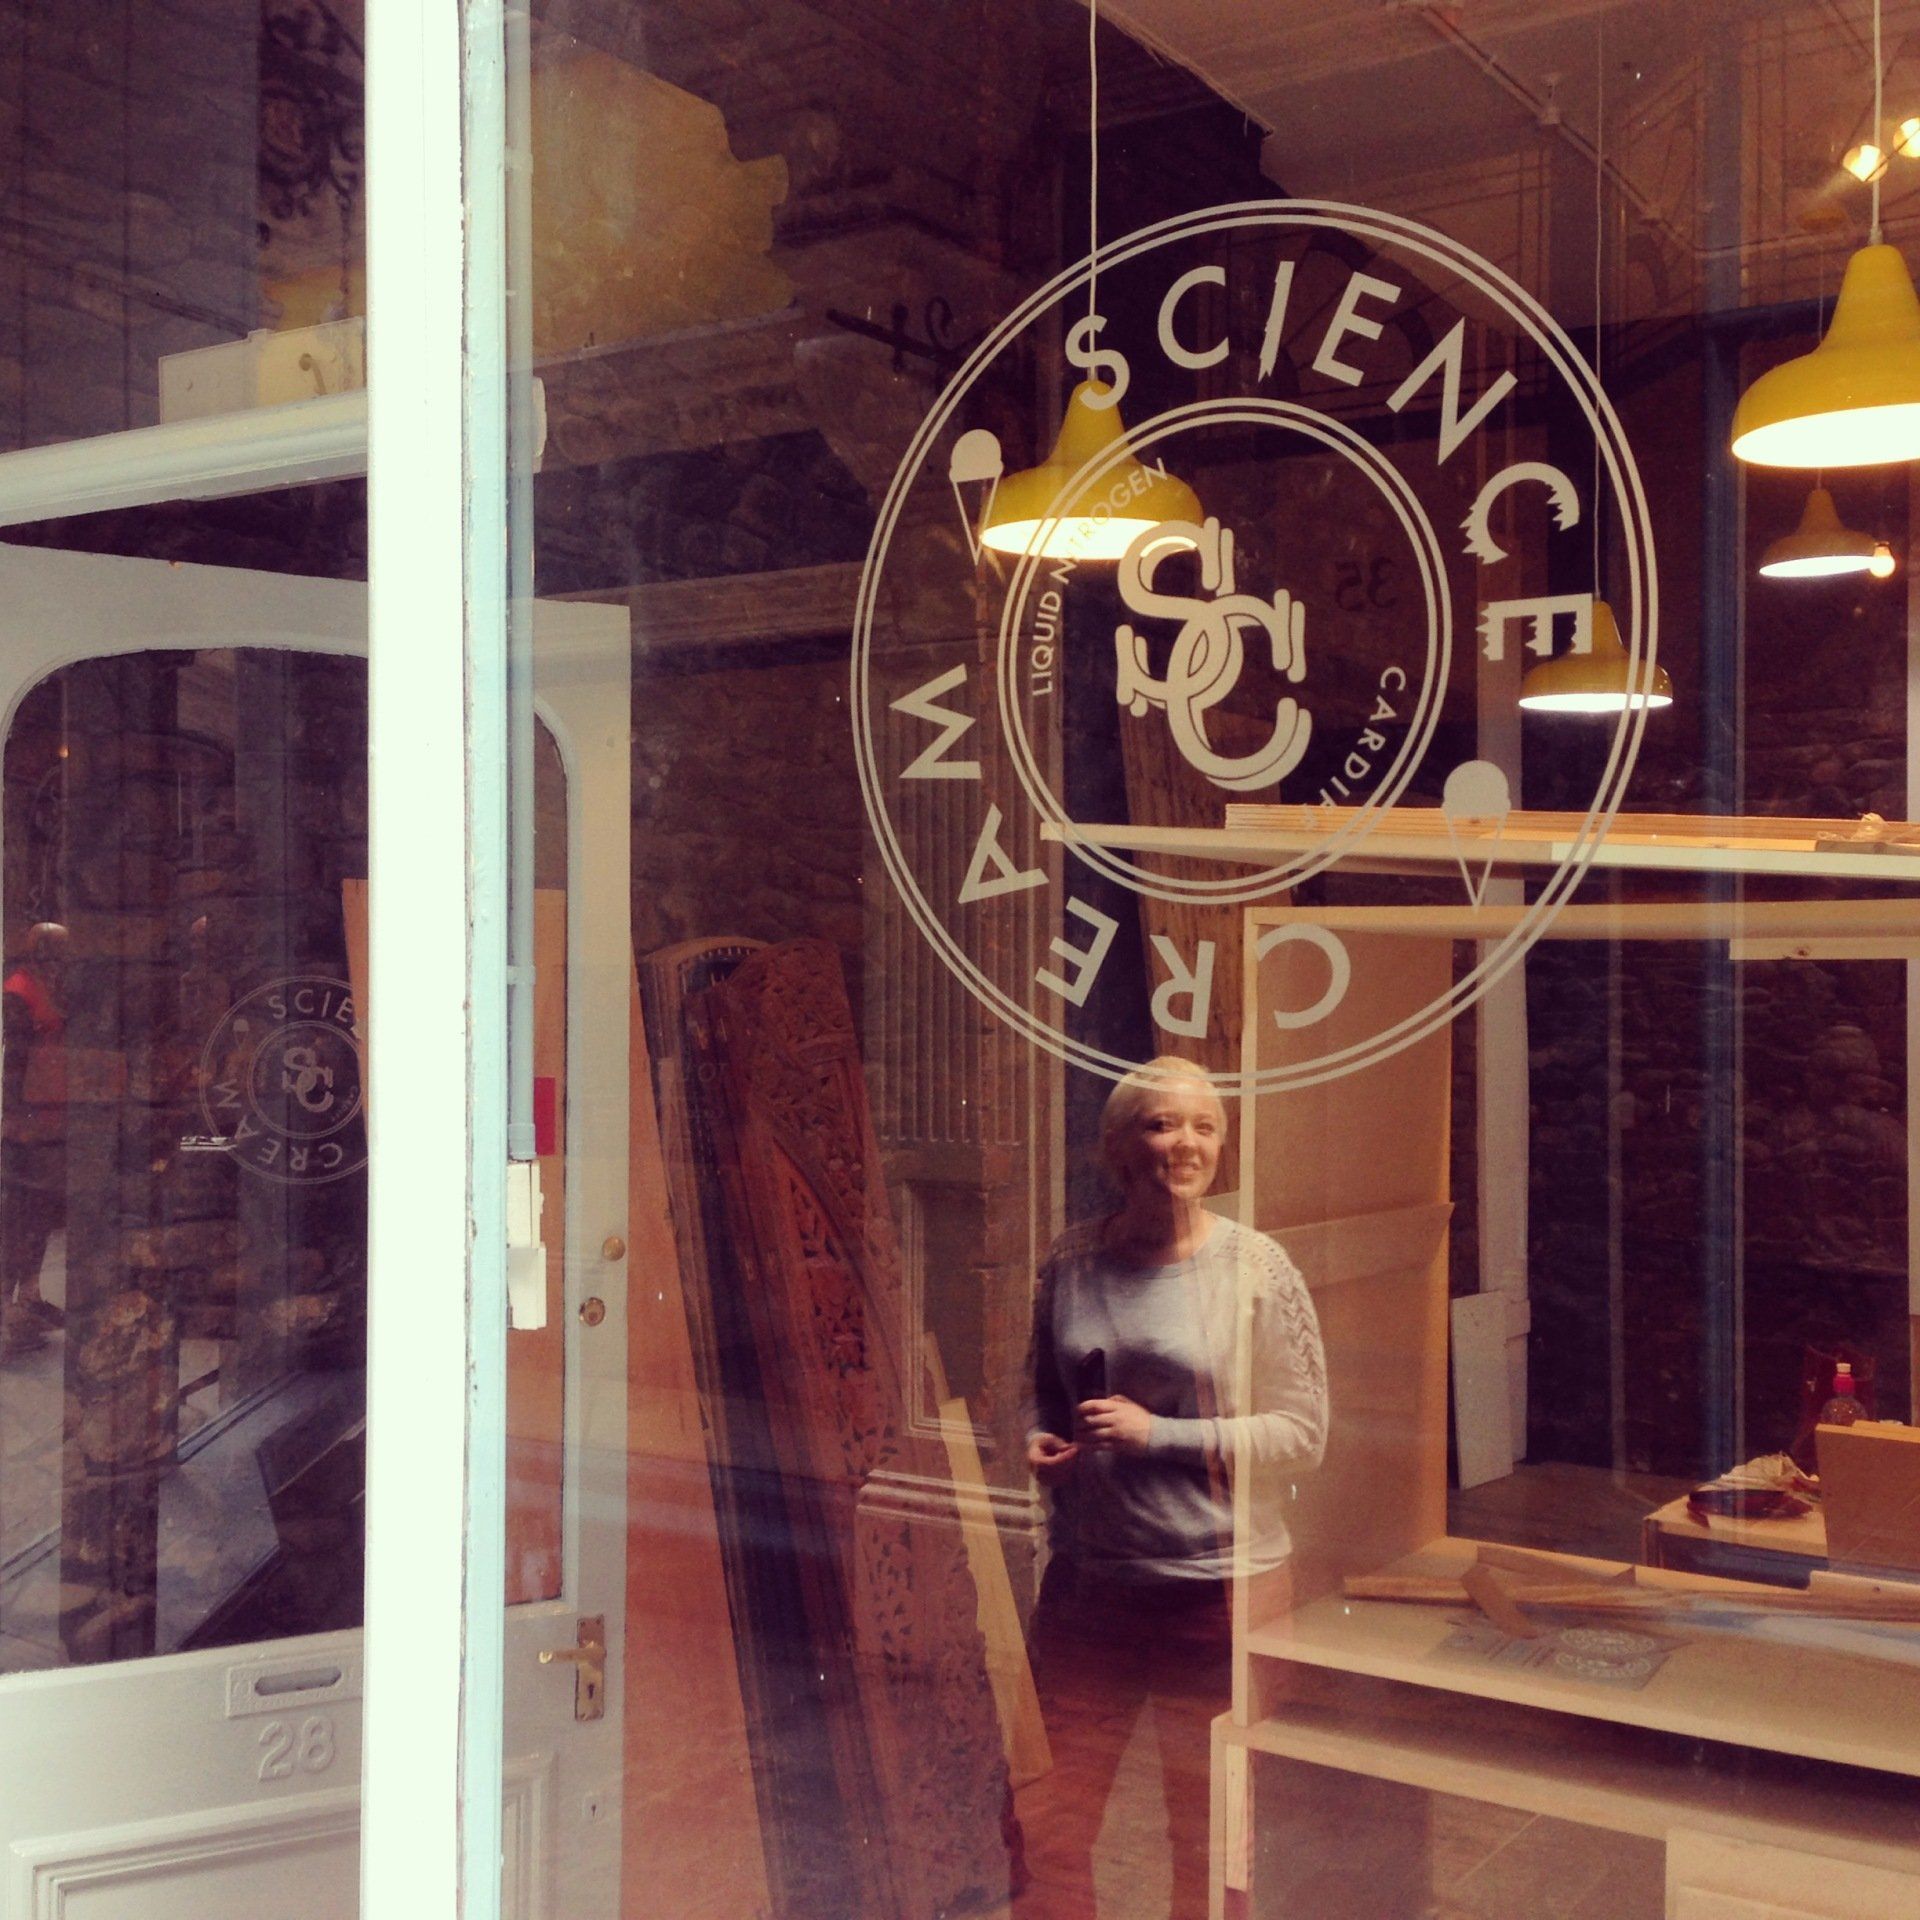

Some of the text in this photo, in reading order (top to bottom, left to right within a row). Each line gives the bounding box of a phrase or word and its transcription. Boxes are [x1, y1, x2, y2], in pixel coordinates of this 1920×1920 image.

[1065, 261, 1593, 661] SCIENCE
[1031, 591, 1062, 696] LIQUID
[889, 664, 1350, 1040] CREAM
[212, 1078, 344, 1172] CREAM
[256, 1716, 336, 1783] 28
